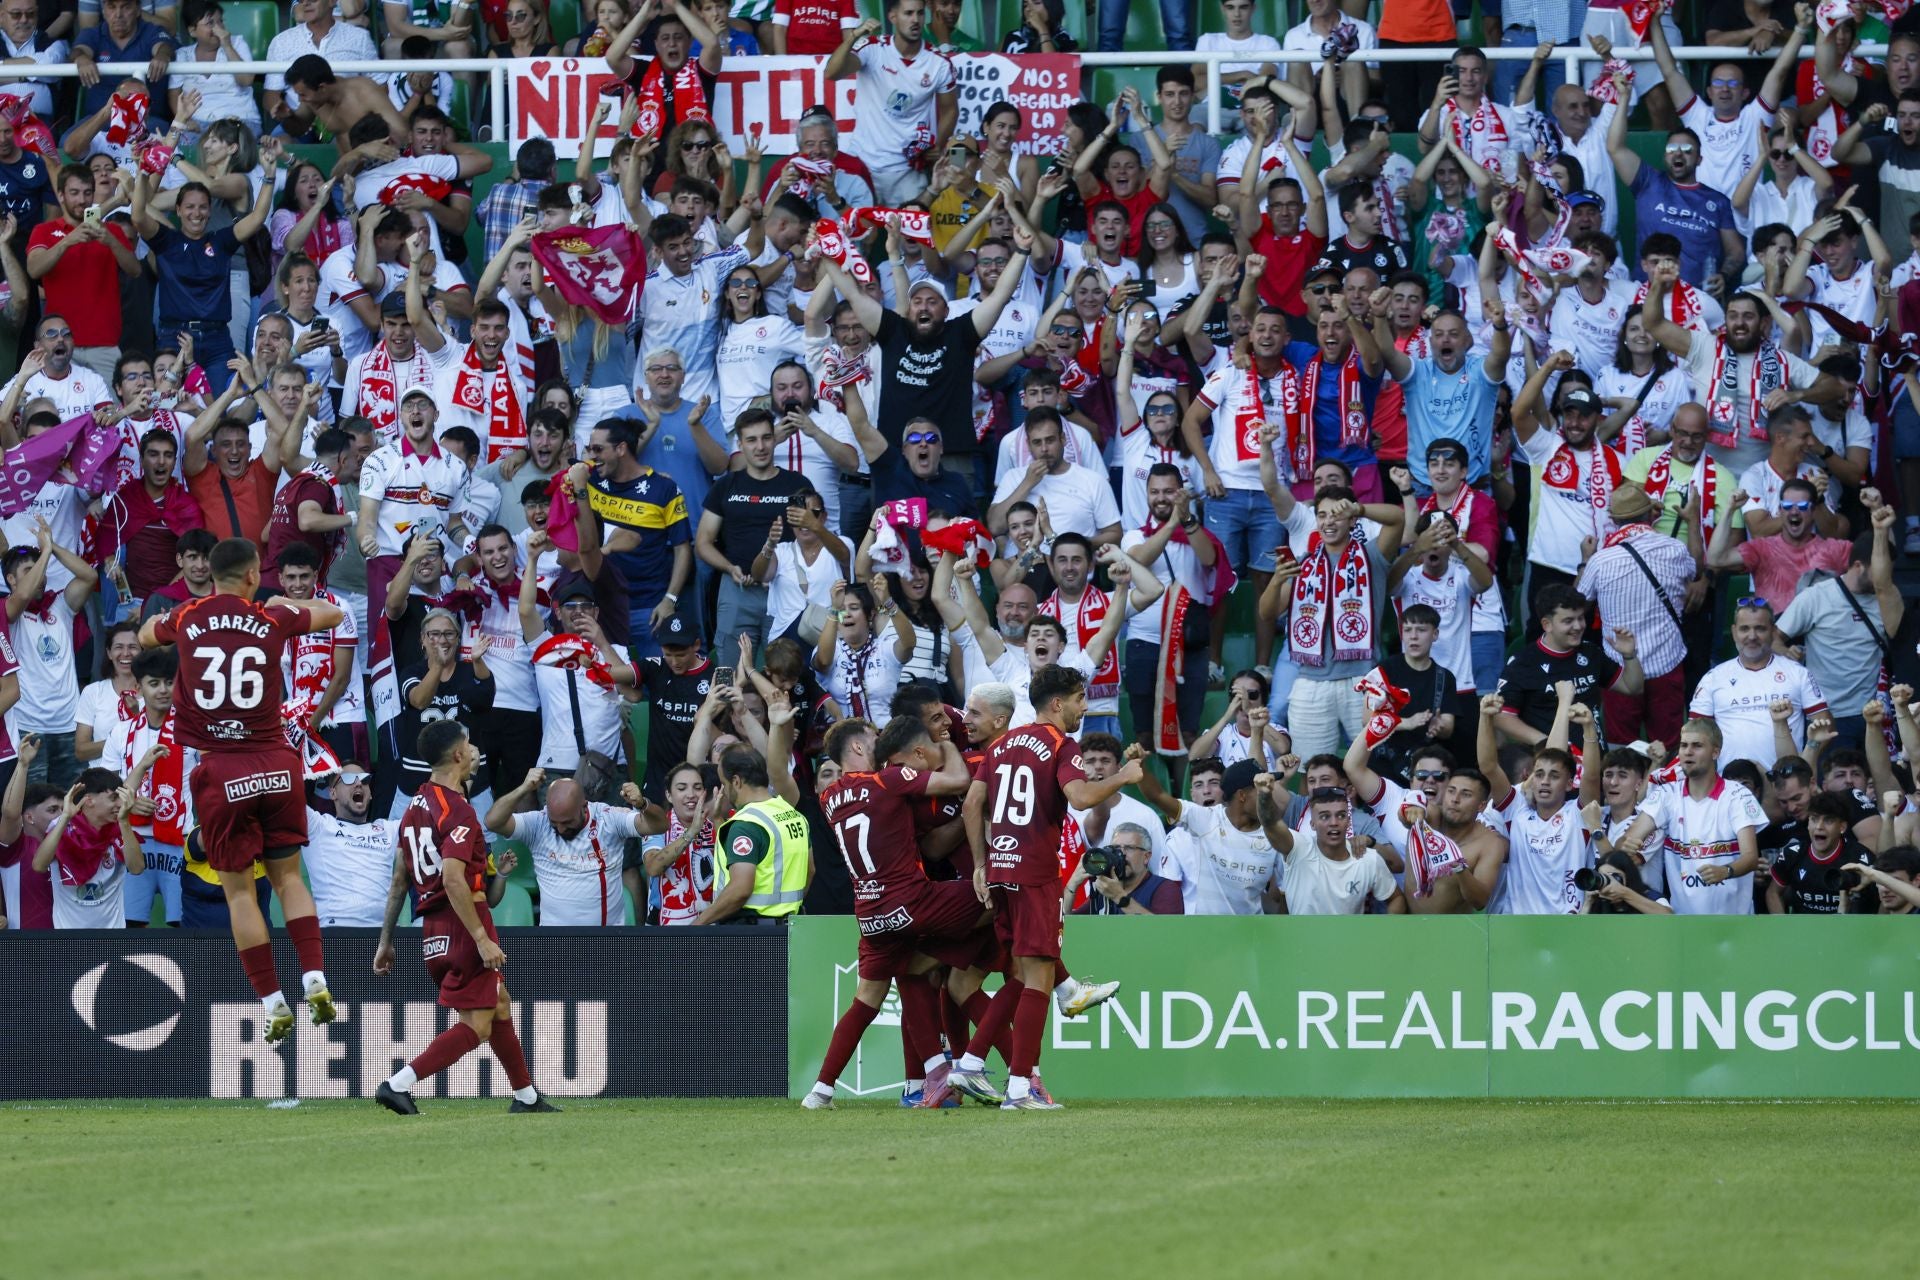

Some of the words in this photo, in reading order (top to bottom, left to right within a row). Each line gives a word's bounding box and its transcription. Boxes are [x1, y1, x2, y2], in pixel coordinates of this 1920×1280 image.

[794, 6, 838, 20] ASPIRE
[1032, 112, 1055, 128] LA
[720, 345, 766, 355] SPIRE
[593, 494, 645, 515] ASPIRE
[728, 494, 750, 504] JACK
[760, 495, 789, 504] JONES
[185, 623, 207, 641] M.
[208, 614, 270, 640] BARŽIĆ
[192, 646, 267, 710] 36
[1545, 675, 1596, 693] AIRE
[656, 698, 698, 713] ASPIR
[662, 712, 694, 723] CADEM
[1006, 734, 1052, 762] SOBRINO
[992, 763, 1035, 826] 19
[786, 822, 804, 840] 195
[1530, 834, 1563, 845] PIRE
[834, 812, 877, 880] 17
[404, 826, 443, 885] 14
[990, 852, 1022, 864] HYUNDAI
[1431, 853, 1449, 865] 1923
